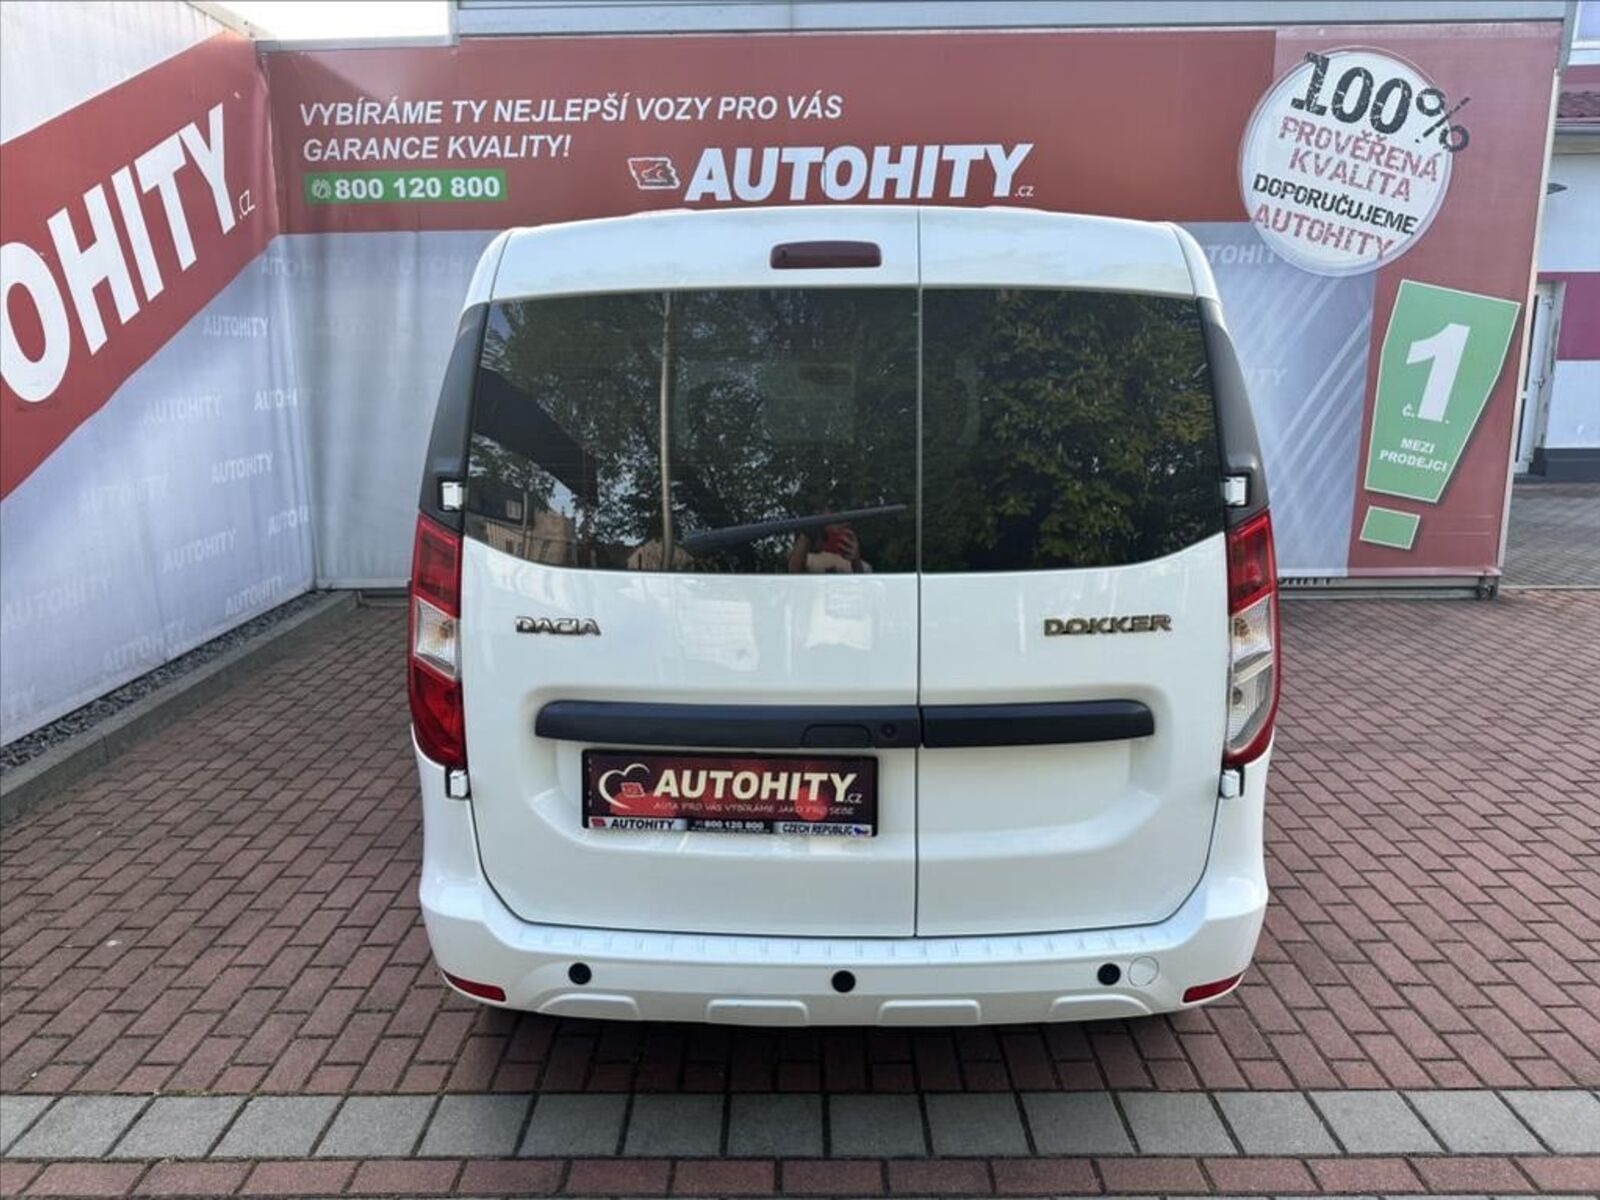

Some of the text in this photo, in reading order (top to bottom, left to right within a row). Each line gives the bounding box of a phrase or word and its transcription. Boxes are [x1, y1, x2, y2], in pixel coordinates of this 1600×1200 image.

[300, 90, 843, 126] VYBÍRÁME TY NEJLEPŠÍ VOZY PRO VÁS
[1291, 52, 1471, 151] 100%
[303, 134, 572, 162] GARANCE KVALITY!
[1278, 116, 1443, 182] PROVĚŘENÁ
[684, 143, 1035, 201] AUTOHITY
[1289, 148, 1411, 202] KVALITA
[335, 176, 500, 199] 800 120 800
[1253, 173, 1419, 236] DOPORUČUJEME
[1251, 203, 1394, 261] AUTOHITY
[202, 316, 271, 338] AUTOHITY
[1400, 437, 1436, 454] MEZI
[211, 452, 274, 485] AUTOHITY
[1379, 449, 1448, 473] PRODEJCI
[515, 616, 602, 637] DACIA
[1044, 614, 1172, 637] DOKKER
[652, 768, 856, 802] AUTOHITY
[653, 802, 679, 811] AUTA
[681, 803, 702, 812] PRO
[611, 819, 675, 830] AUTOHITY
[782, 823, 852, 834] CZECH REPUBLIC
